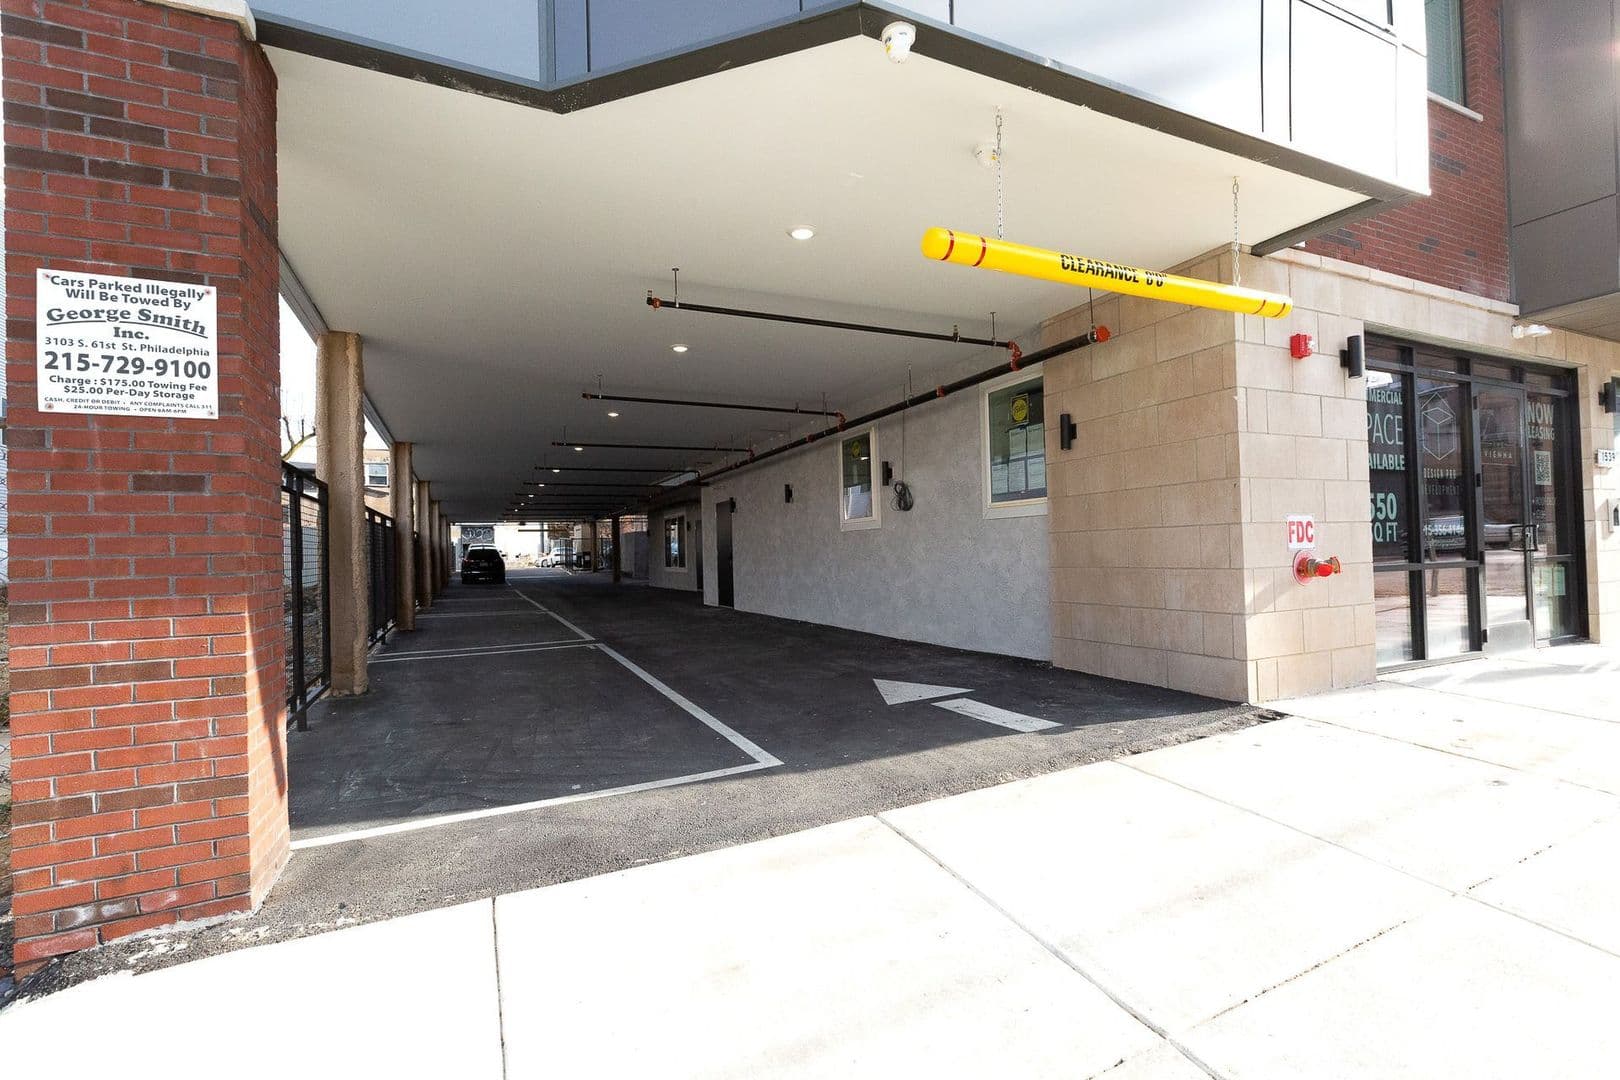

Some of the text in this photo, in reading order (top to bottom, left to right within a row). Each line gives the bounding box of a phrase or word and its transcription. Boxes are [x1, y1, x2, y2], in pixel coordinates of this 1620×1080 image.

[1060, 254, 1139, 283] CLEARANCE
[50, 275, 205, 301] Cars Parked Illegally
[65, 288, 191, 311] Will Be Towed By
[46, 308, 206, 335] George Smith
[113, 326, 149, 340] Inc.
[45, 336, 210, 357] 3103 S. 61st St. Philadelphia
[44, 351, 211, 379] 215-729-9100
[49, 375, 91, 386] Charge
[100, 377, 145, 388] $175.00
[147, 380, 187, 392] Towing
[189, 383, 207, 392] Fee
[64, 385, 195, 401] $25.00 Per-Day Storage
[1526, 401, 1554, 425] NOW
[1527, 424, 1555, 441] LEASING
[1288, 521, 1314, 543] FDC
[1386, 521, 1398, 542] FT
